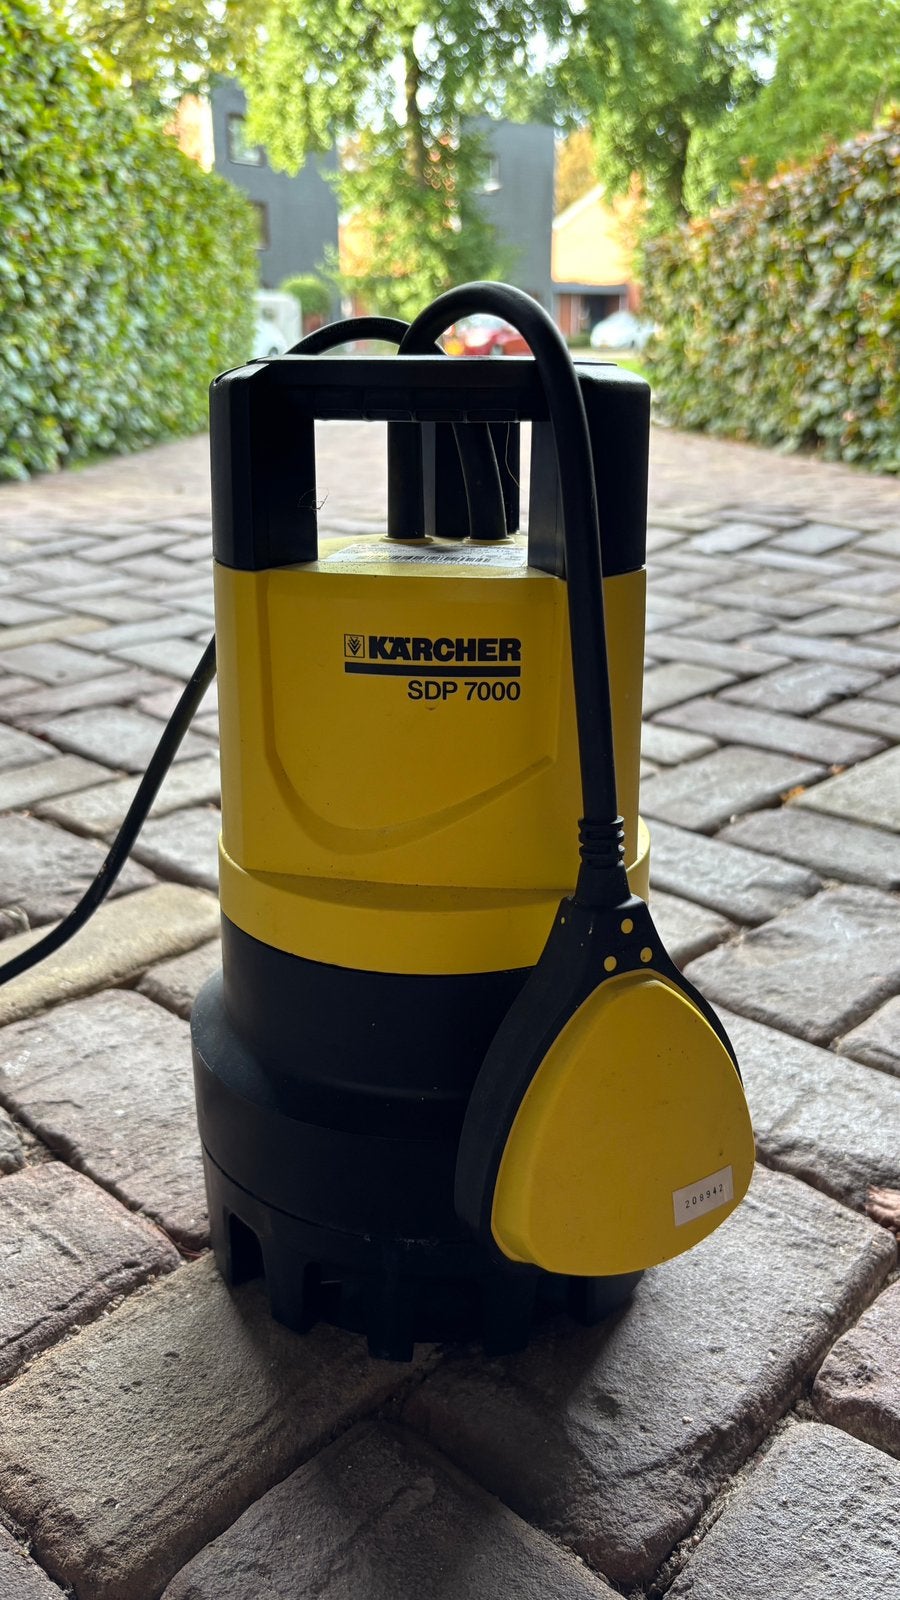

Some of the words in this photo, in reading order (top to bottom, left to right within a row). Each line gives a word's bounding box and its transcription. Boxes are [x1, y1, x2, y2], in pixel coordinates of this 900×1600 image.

[369, 636, 522, 662] KÄRCHER
[407, 680, 458, 700] SDP
[464, 681, 521, 701] 7000
[684, 1183, 724, 1209] 208942
